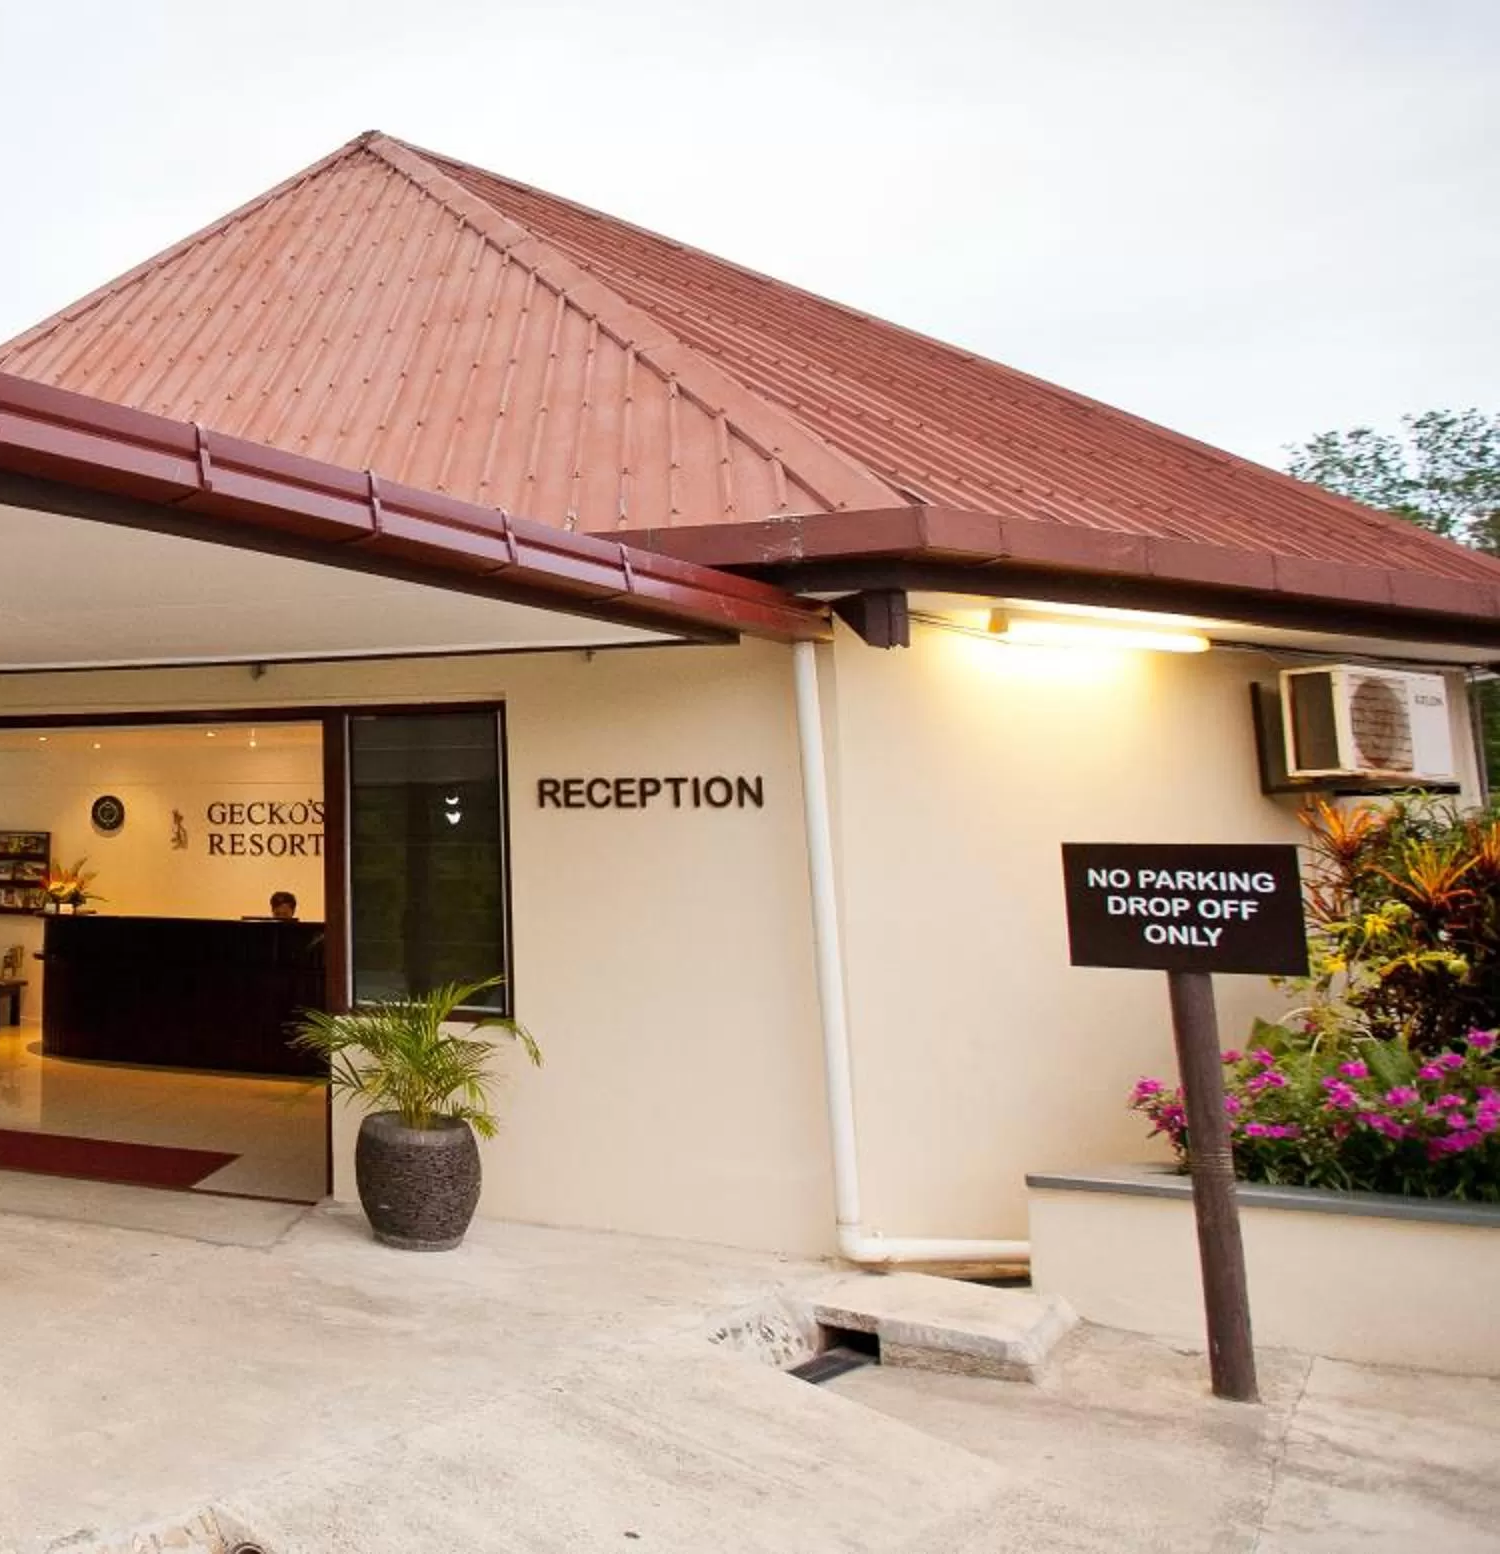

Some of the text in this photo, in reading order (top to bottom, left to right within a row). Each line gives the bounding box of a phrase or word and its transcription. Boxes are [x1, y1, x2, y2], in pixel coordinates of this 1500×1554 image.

[537, 775, 764, 808] RECEPTION
[207, 798, 325, 825] GECKO'S
[208, 833, 325, 856] RESORT
[1087, 868, 1276, 892] NO PARKING
[1106, 895, 1259, 920] DROP OFF
[1144, 924, 1222, 946] ONLY
